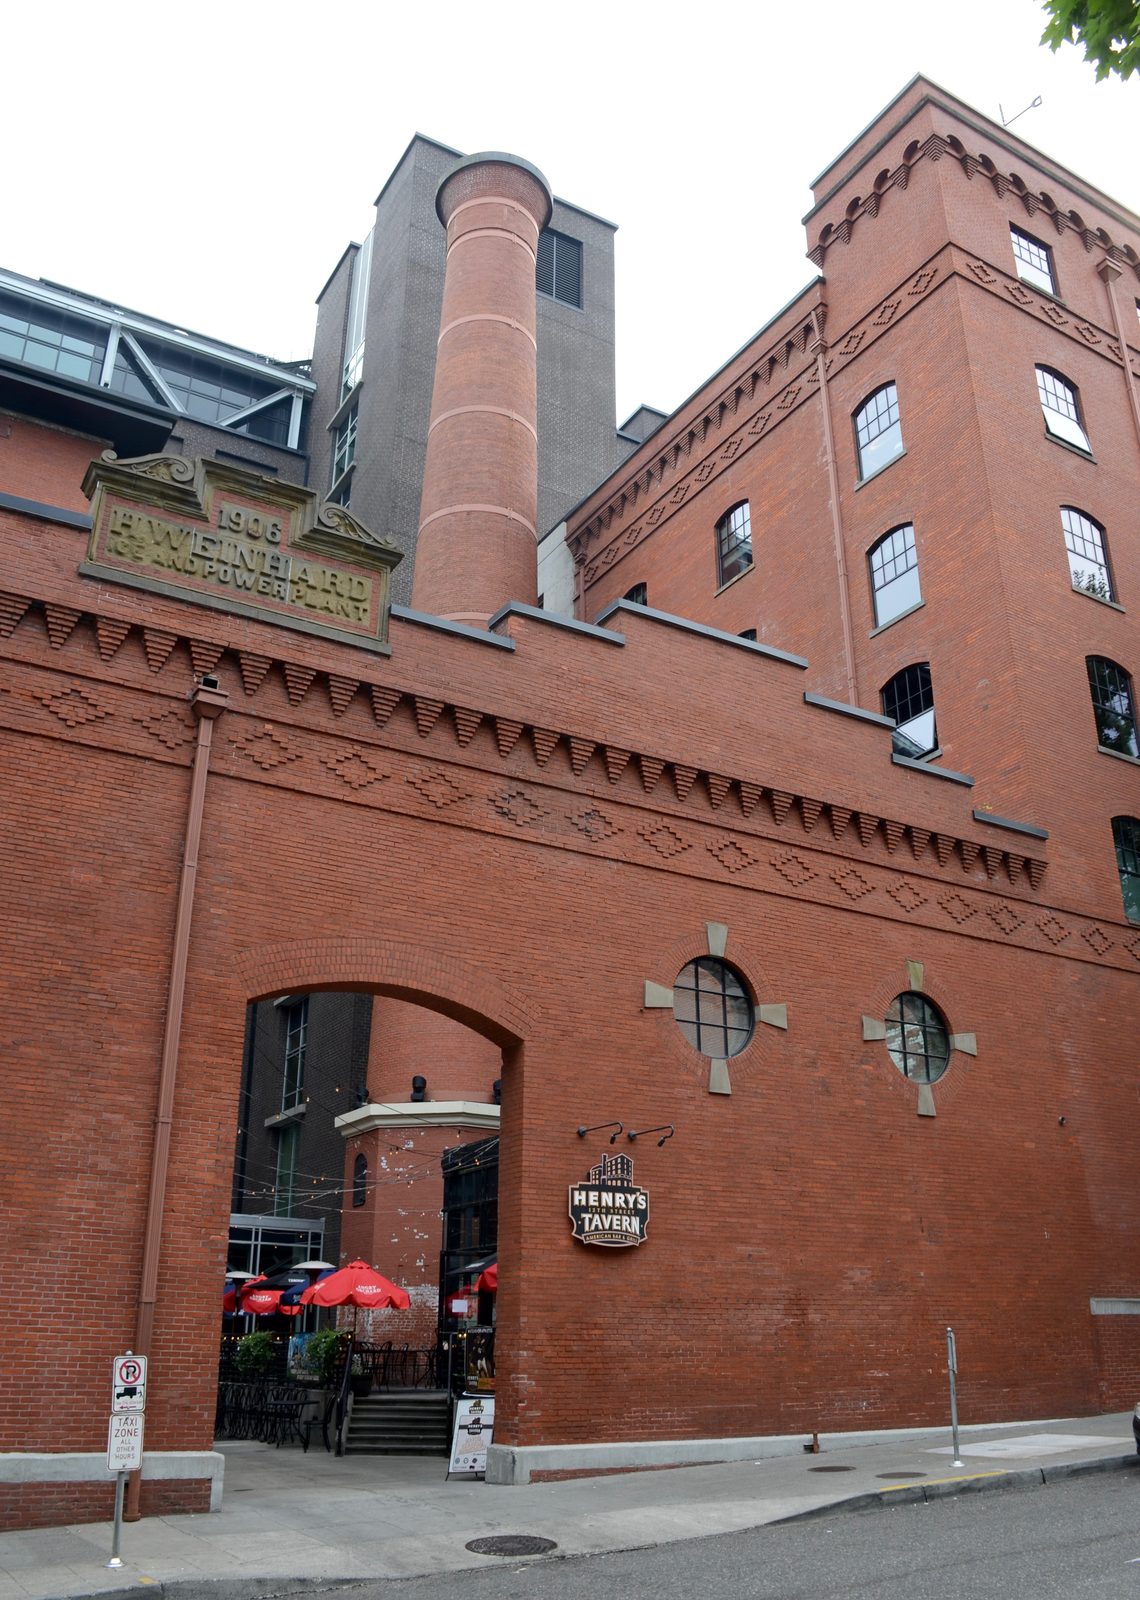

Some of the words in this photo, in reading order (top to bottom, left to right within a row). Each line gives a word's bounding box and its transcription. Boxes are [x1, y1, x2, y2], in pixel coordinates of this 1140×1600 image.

[218, 508, 282, 545] 1906
[148, 518, 369, 603] WEINHARD
[106, 538, 146, 561] ICE
[151, 548, 197, 575] AND
[202, 560, 287, 600] POWER
[291, 584, 369, 621] PLANT
[573, 1190, 647, 1209] HENRY'S
[580, 1213, 640, 1235] TAVERN
[114, 1428, 139, 1438] ZONE
[118, 1417, 138, 1427] TAXI
